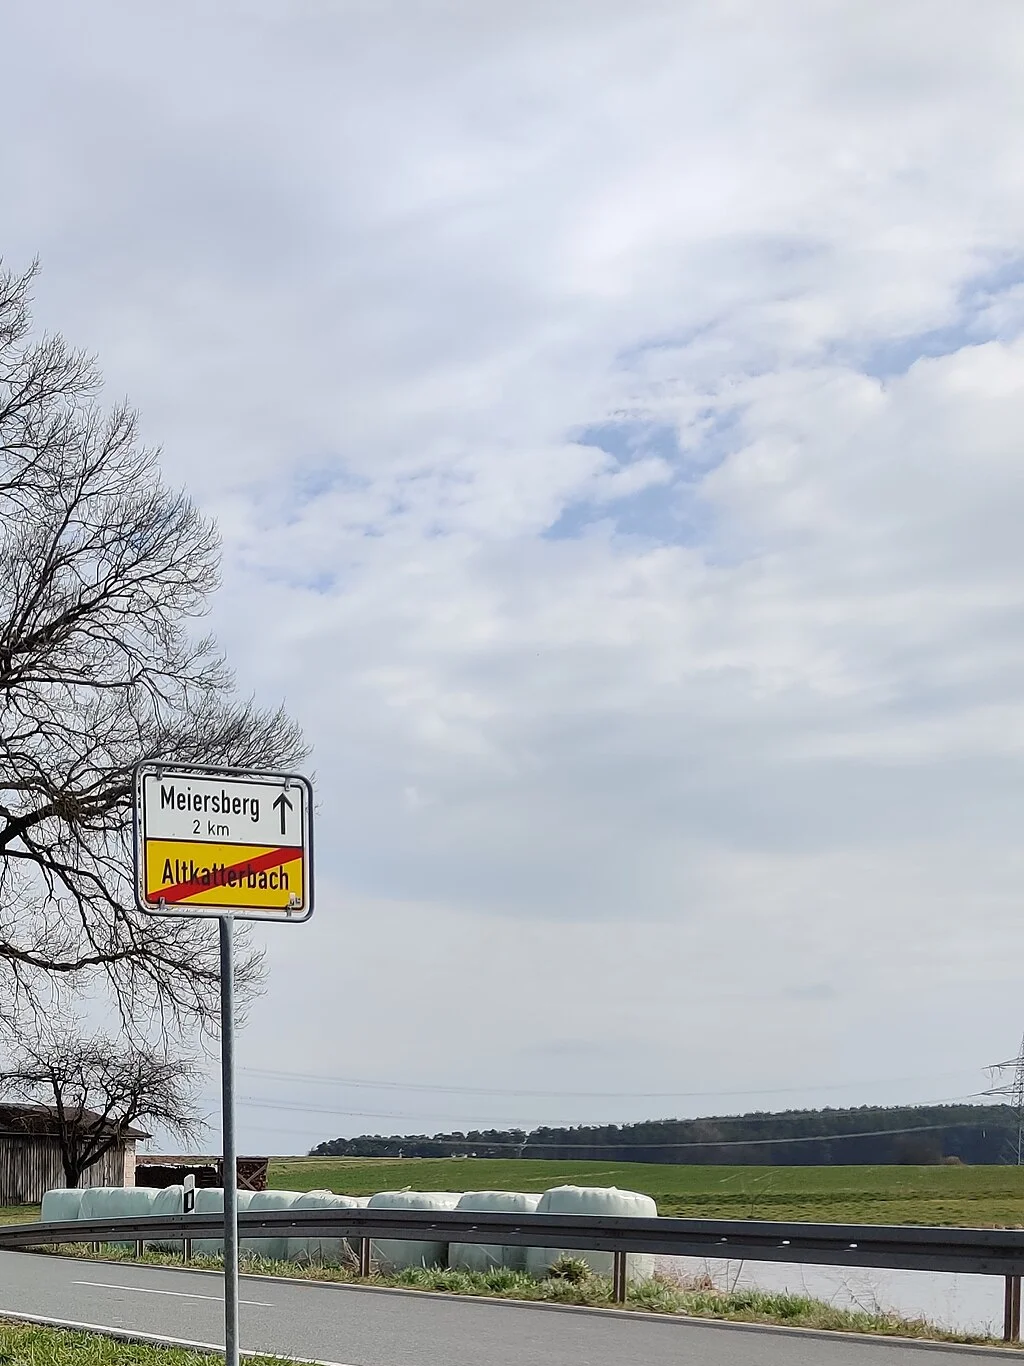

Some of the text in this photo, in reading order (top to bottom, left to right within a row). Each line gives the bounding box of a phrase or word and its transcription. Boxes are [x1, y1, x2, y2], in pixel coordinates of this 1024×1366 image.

[160, 785, 259, 822] Meiersberg
[192, 819, 230, 836] 2 km
[161, 858, 289, 890] Altkatterbach
